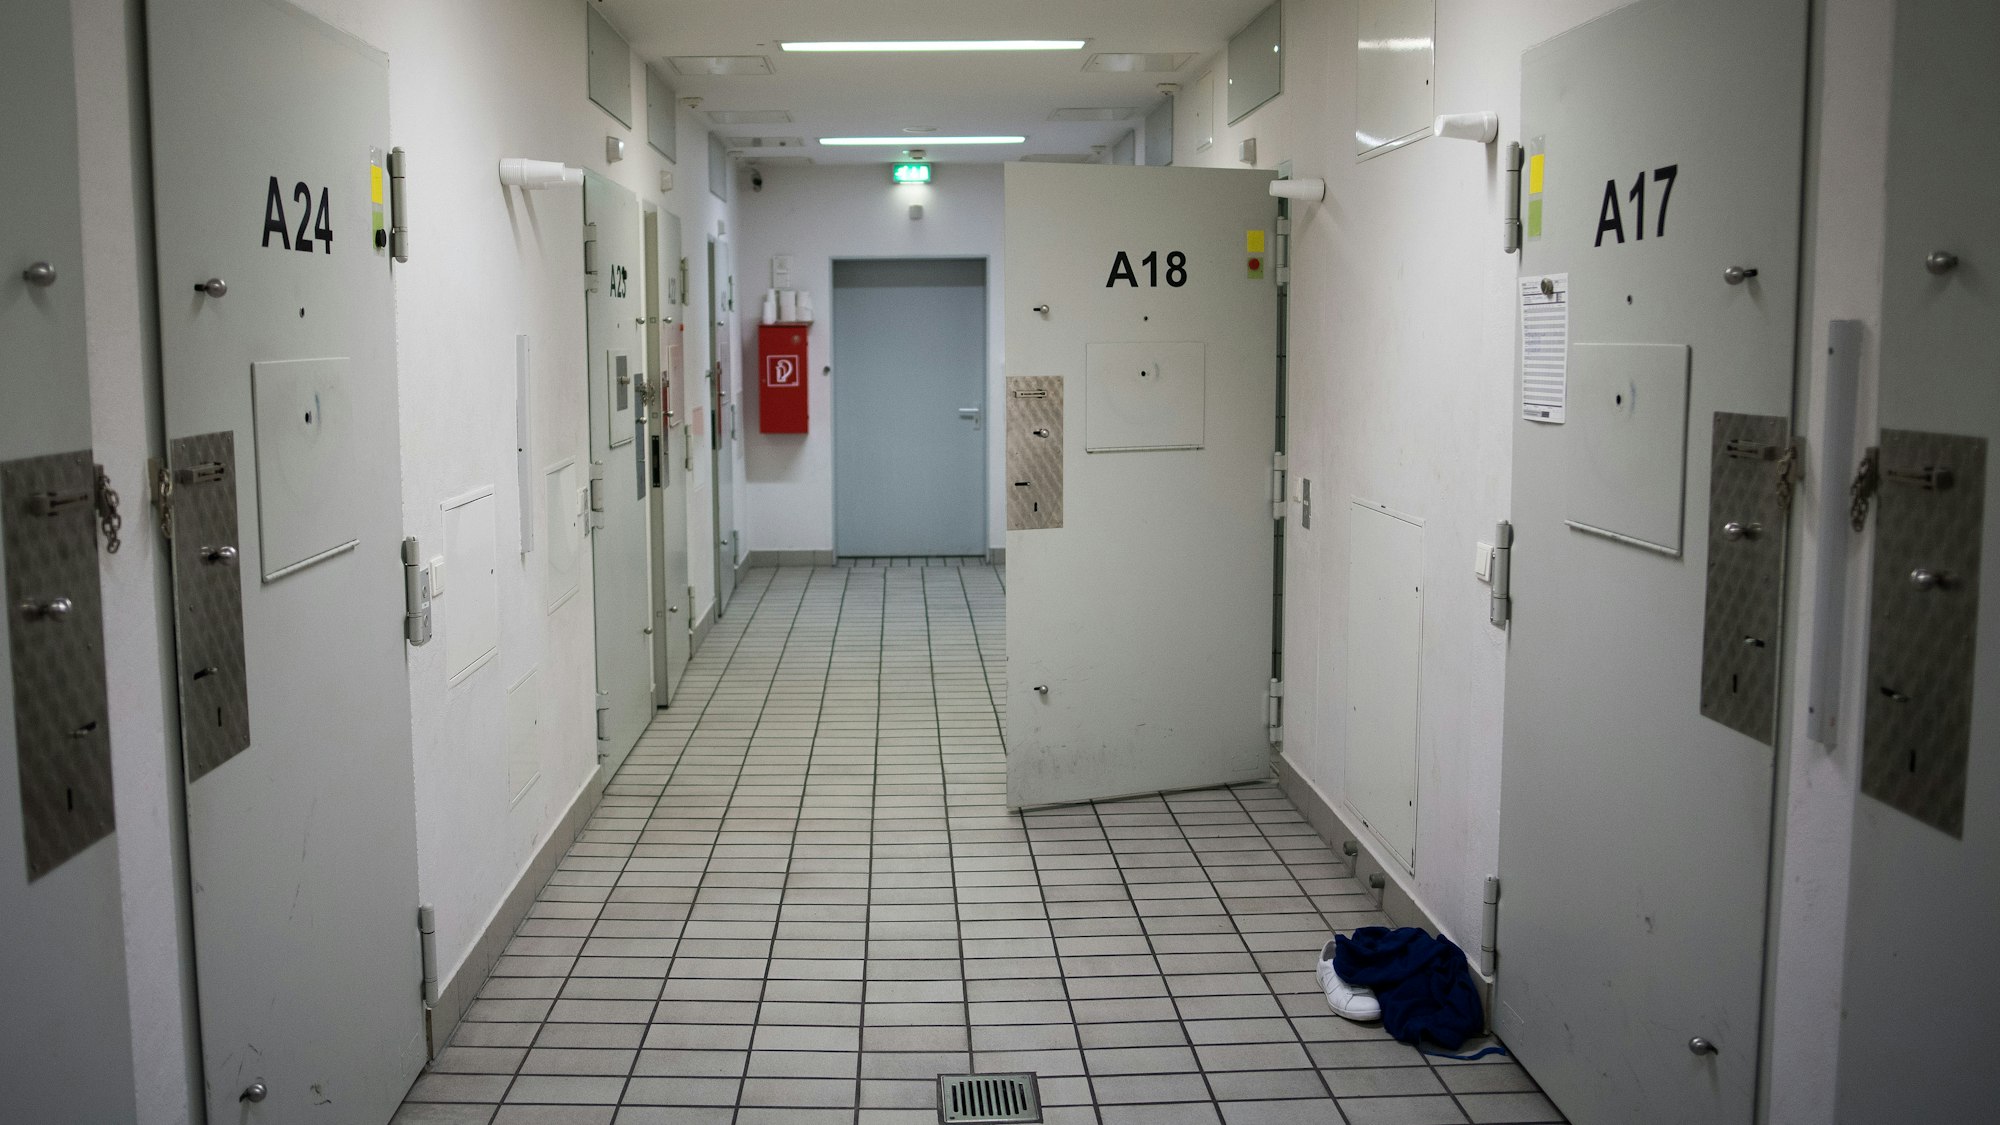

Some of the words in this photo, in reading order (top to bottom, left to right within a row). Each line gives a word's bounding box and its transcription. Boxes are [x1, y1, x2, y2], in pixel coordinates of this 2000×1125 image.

[262, 175, 333, 254] A24
[1594, 164, 1678, 248] A17
[610, 264, 627, 298] A23
[1106, 250, 1187, 288] A18
